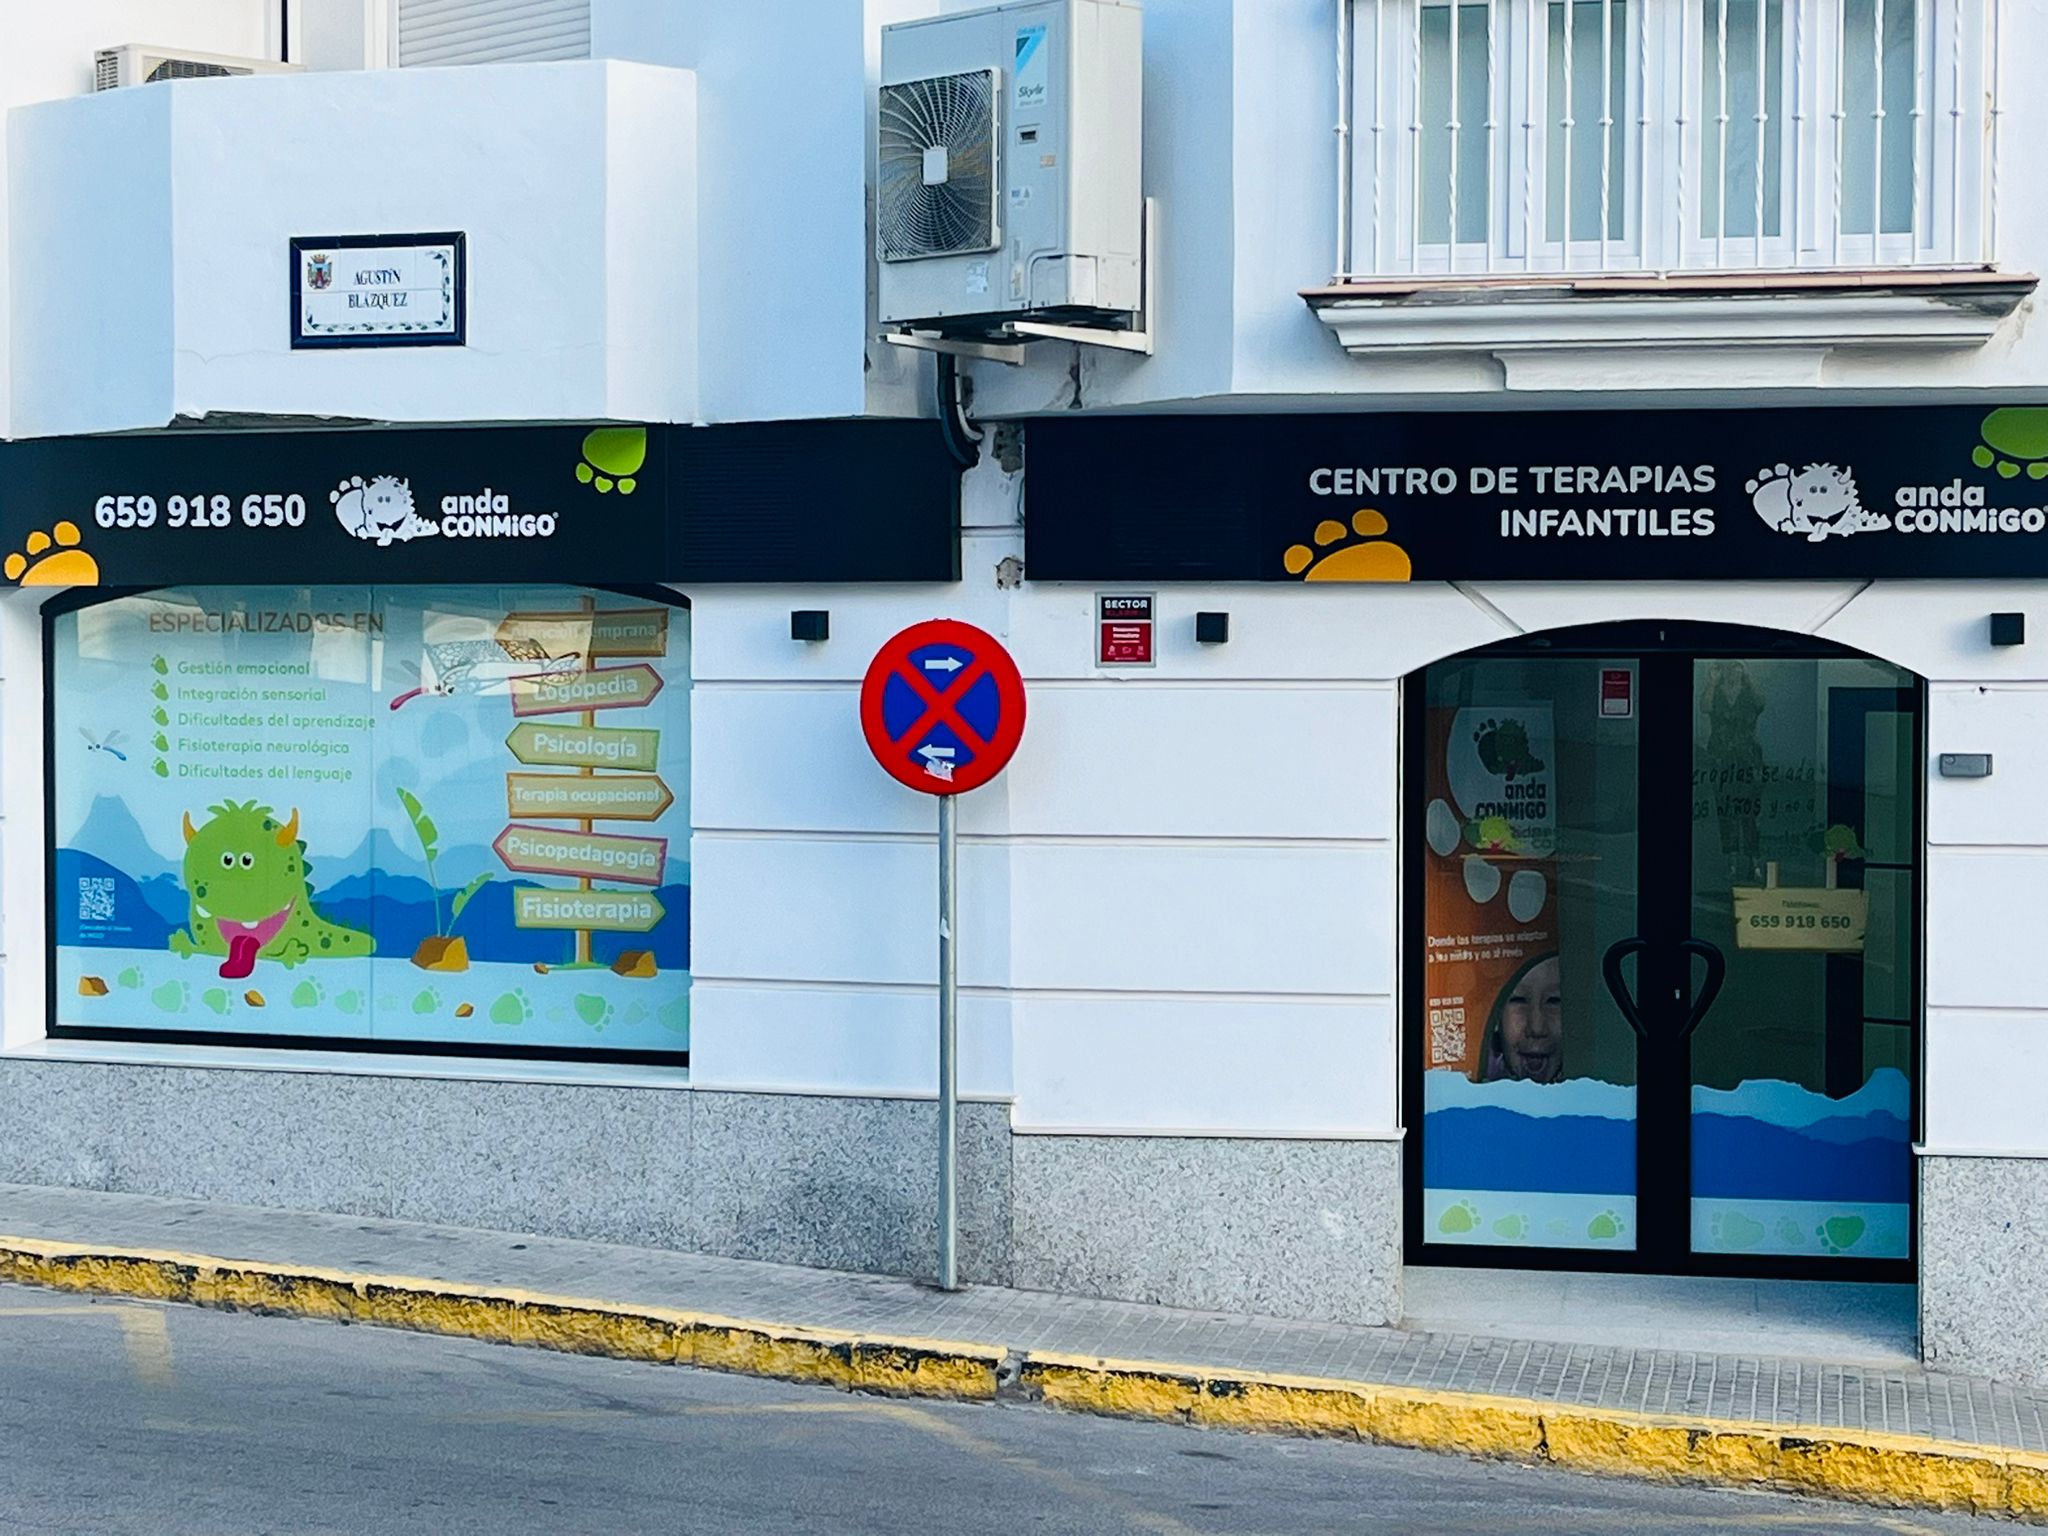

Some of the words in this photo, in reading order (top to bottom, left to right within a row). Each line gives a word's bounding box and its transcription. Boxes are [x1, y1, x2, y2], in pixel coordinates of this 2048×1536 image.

[353, 268, 401, 285] AGUSTÍN
[348, 290, 408, 310] BLÁZQUEZ
[1309, 467, 1457, 495] CENTRO
[1470, 466, 1519, 494] DE
[1529, 465, 1716, 494] TERAPIAS
[441, 488, 509, 515] anda
[1895, 478, 1985, 507] anda
[94, 495, 157, 528] 659
[167, 494, 231, 528] 918
[241, 494, 306, 527] 650
[1501, 508, 1716, 537] INFANTILES
[1104, 599, 1148, 609] SECTOR
[149, 611, 346, 634] ESPECIALIZADOS
[354, 612, 384, 634] EN
[177, 660, 232, 676] Gestión
[236, 660, 311, 676] emocional
[177, 687, 258, 703] Integración
[262, 687, 326, 701] sensorial
[533, 674, 639, 704] Logopedia
[178, 713, 263, 728] Dificultades
[267, 714, 290, 728] del
[293, 713, 376, 731] aprendizaje
[178, 738, 263, 755] Fisioterapia
[267, 739, 350, 757] neurológica
[533, 732, 638, 761] Psicología
[178, 764, 263, 780] Dificultades
[267, 764, 289, 780] del
[292, 765, 353, 784] lenguaje
[514, 786, 568, 805] Terapia
[570, 787, 661, 806] ocupacional
[1505, 779, 1547, 800] anda
[506, 836, 656, 869] Psicopedagogía
[522, 895, 653, 924] Fisioterapia
[1750, 915, 1780, 929] 659
[1785, 915, 1816, 929] 918
[1820, 915, 1851, 929] 650
